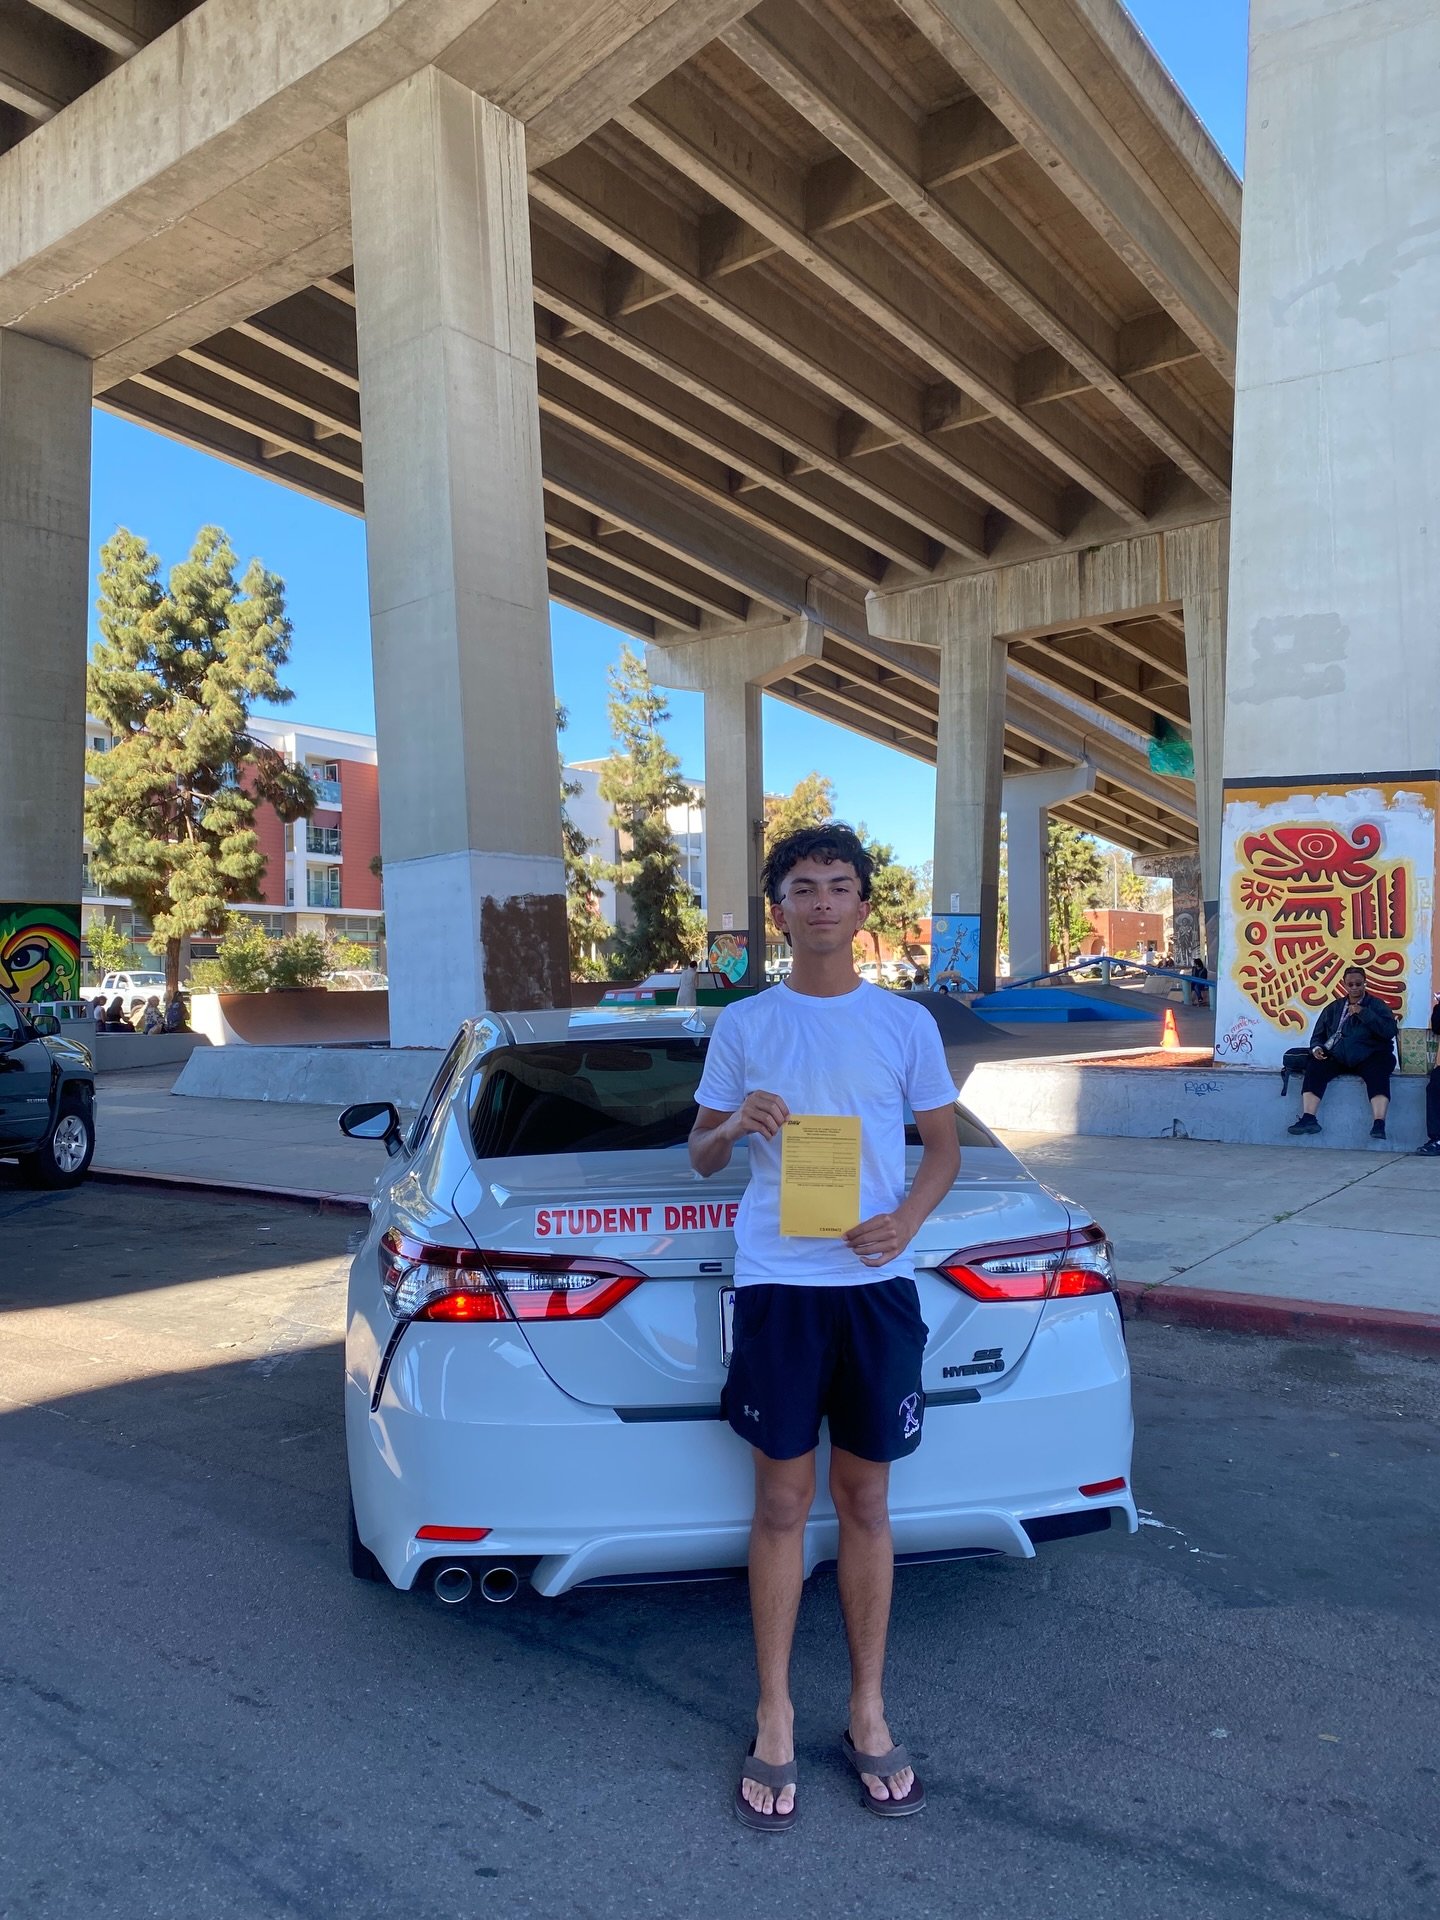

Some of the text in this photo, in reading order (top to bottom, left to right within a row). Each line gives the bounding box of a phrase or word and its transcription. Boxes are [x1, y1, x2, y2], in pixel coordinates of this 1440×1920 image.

[536, 1203, 739, 1236] STUDENT DRIVE
[972, 1347, 1004, 1362] SE
[942, 1361, 995, 1379] HYBRID
